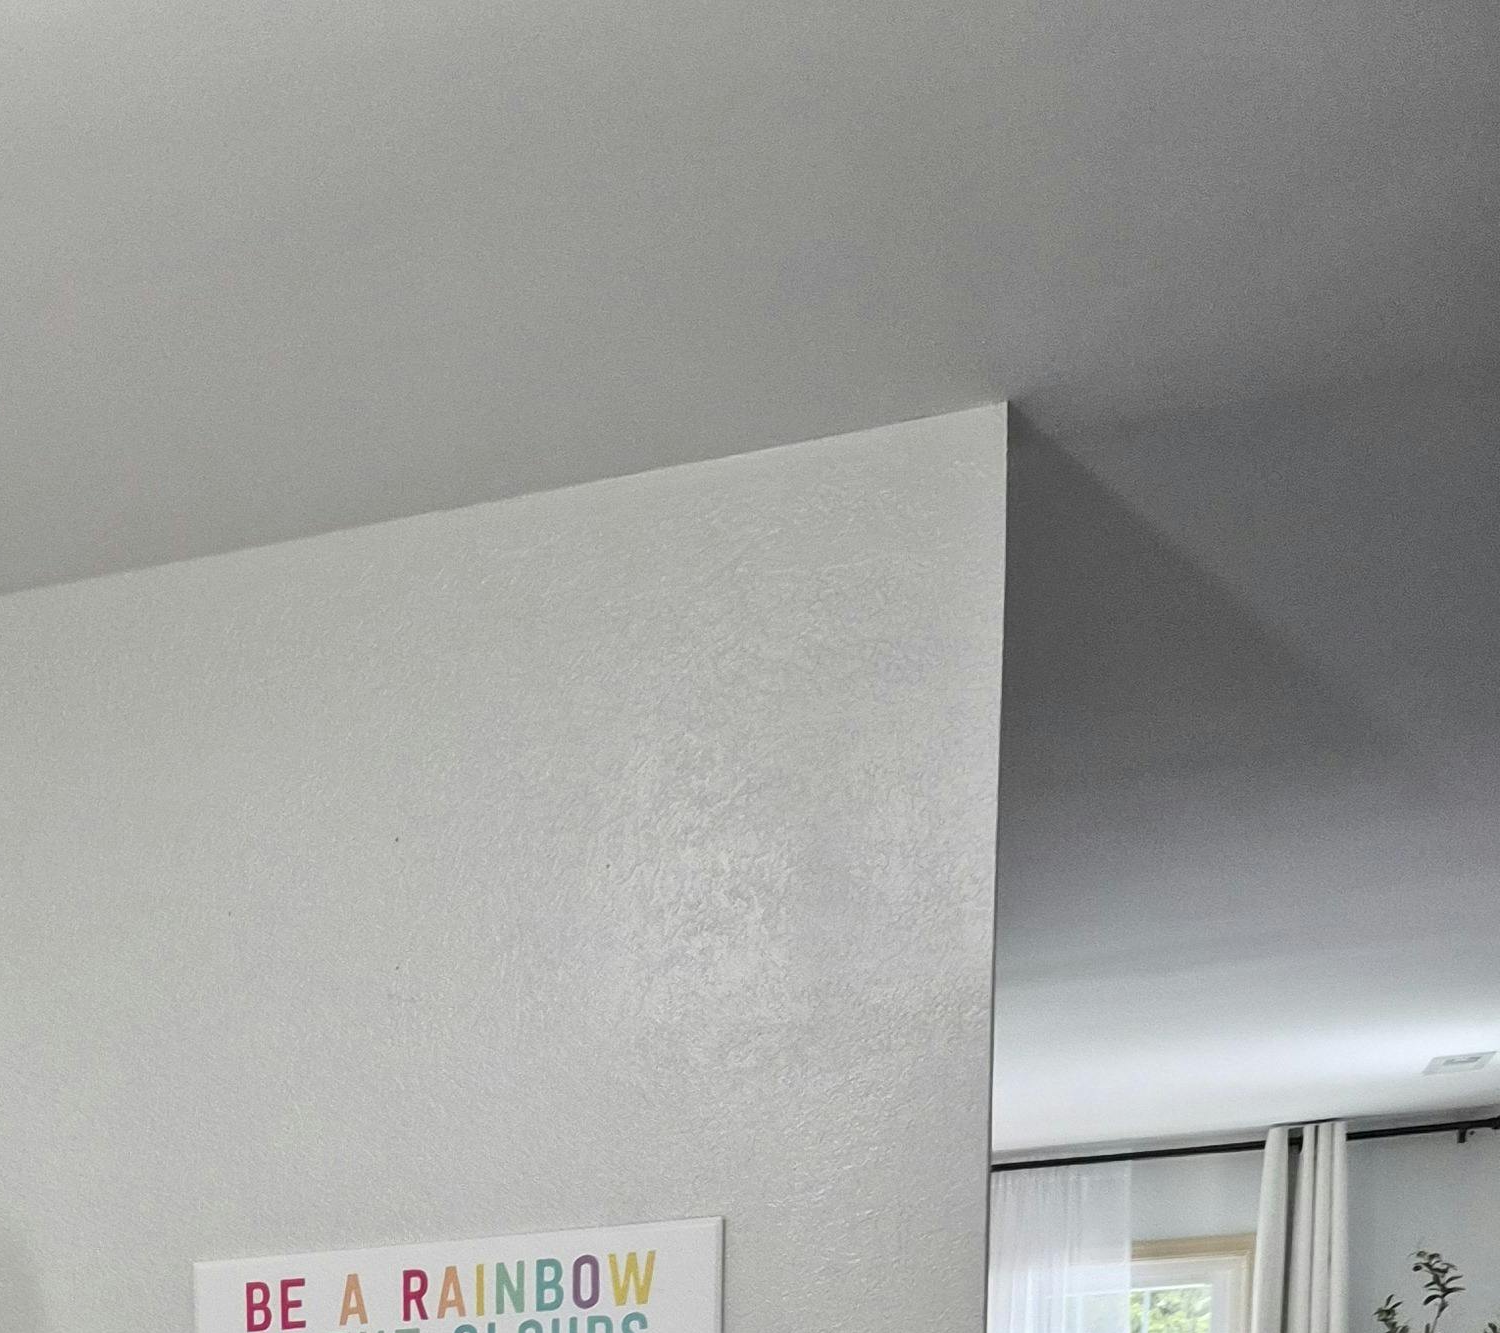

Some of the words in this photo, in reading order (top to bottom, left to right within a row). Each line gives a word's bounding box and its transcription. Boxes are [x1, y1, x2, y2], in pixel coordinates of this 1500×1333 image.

[246, 1278, 306, 1332] BE
[339, 1274, 368, 1326] A
[402, 1251, 656, 1322] RAINBOW
